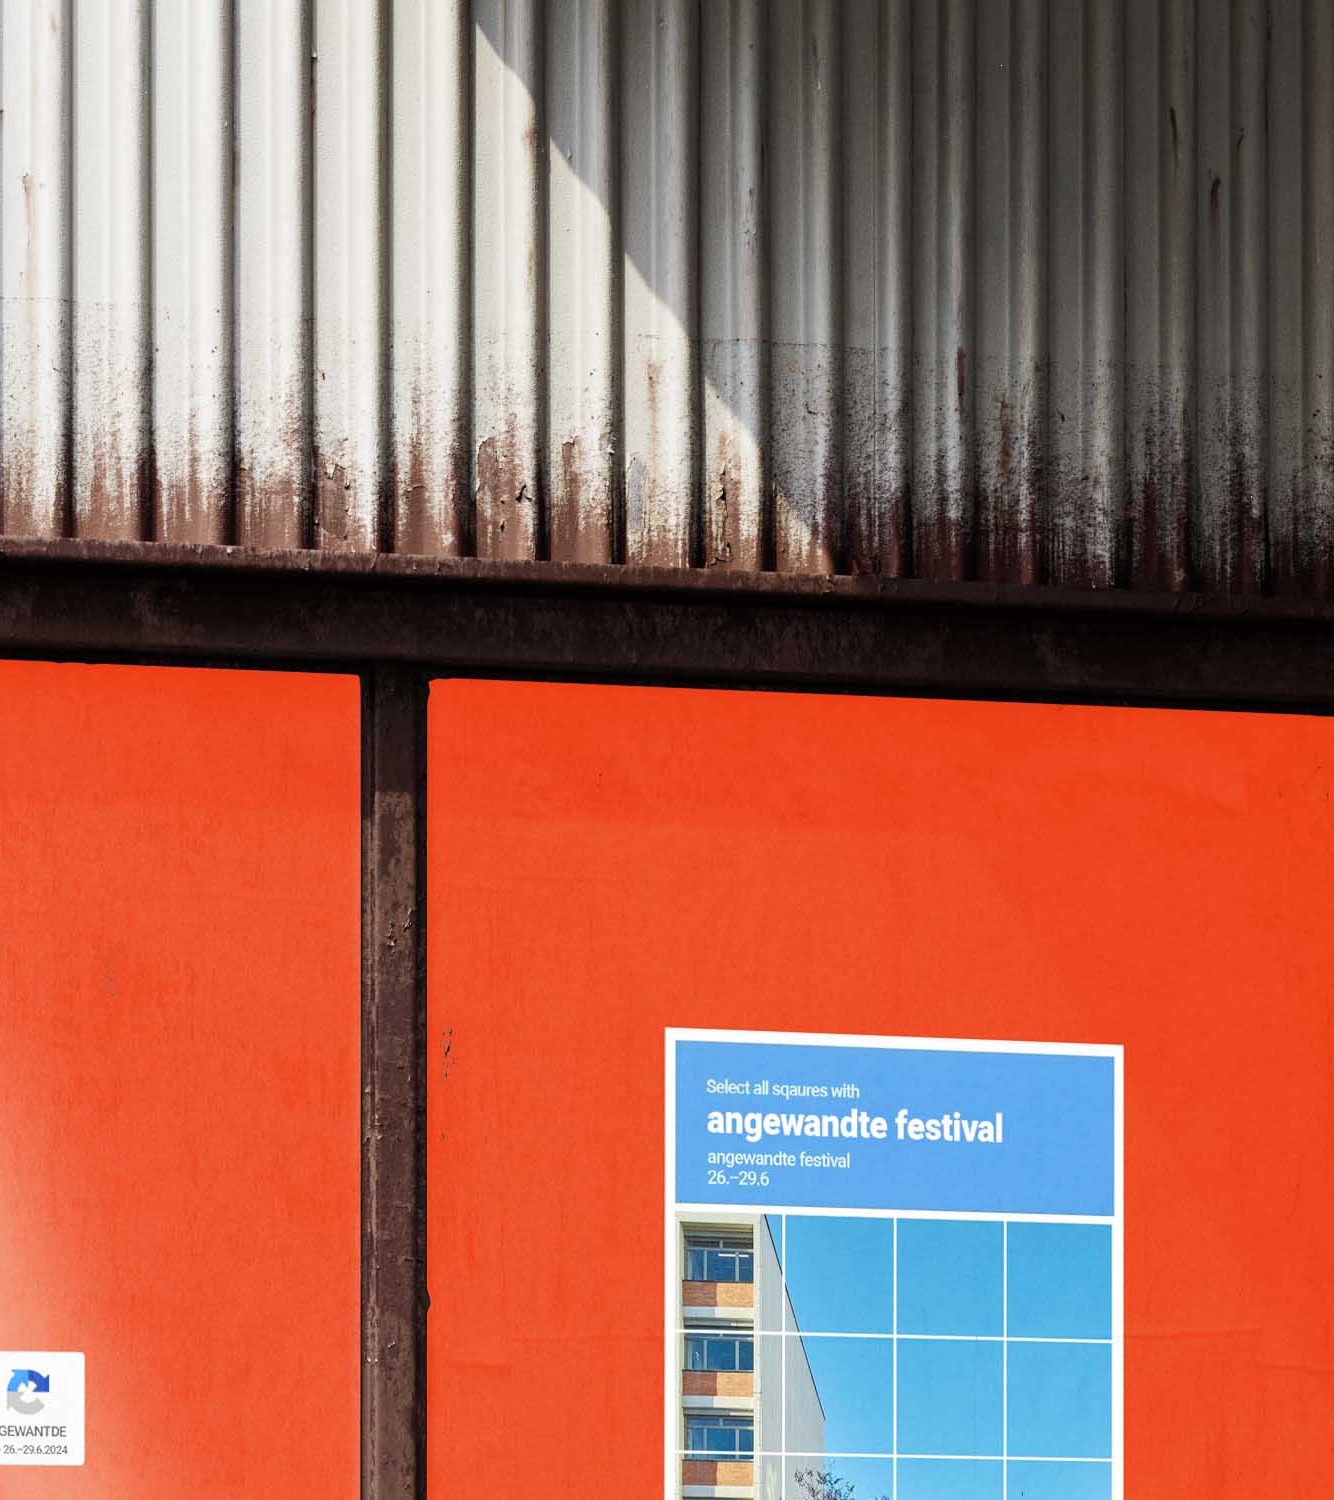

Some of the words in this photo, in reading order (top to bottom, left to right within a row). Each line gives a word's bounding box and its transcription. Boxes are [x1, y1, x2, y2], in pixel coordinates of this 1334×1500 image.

[706, 1079, 751, 1095] Select
[753, 1080, 769, 1096] all
[771, 1085, 828, 1101] sqaures
[830, 1084, 860, 1099] with
[706, 1108, 888, 1143] angewandte
[894, 1109, 1004, 1144] festival
[707, 1151, 797, 1169] angewandte
[799, 1152, 851, 1169] festival
